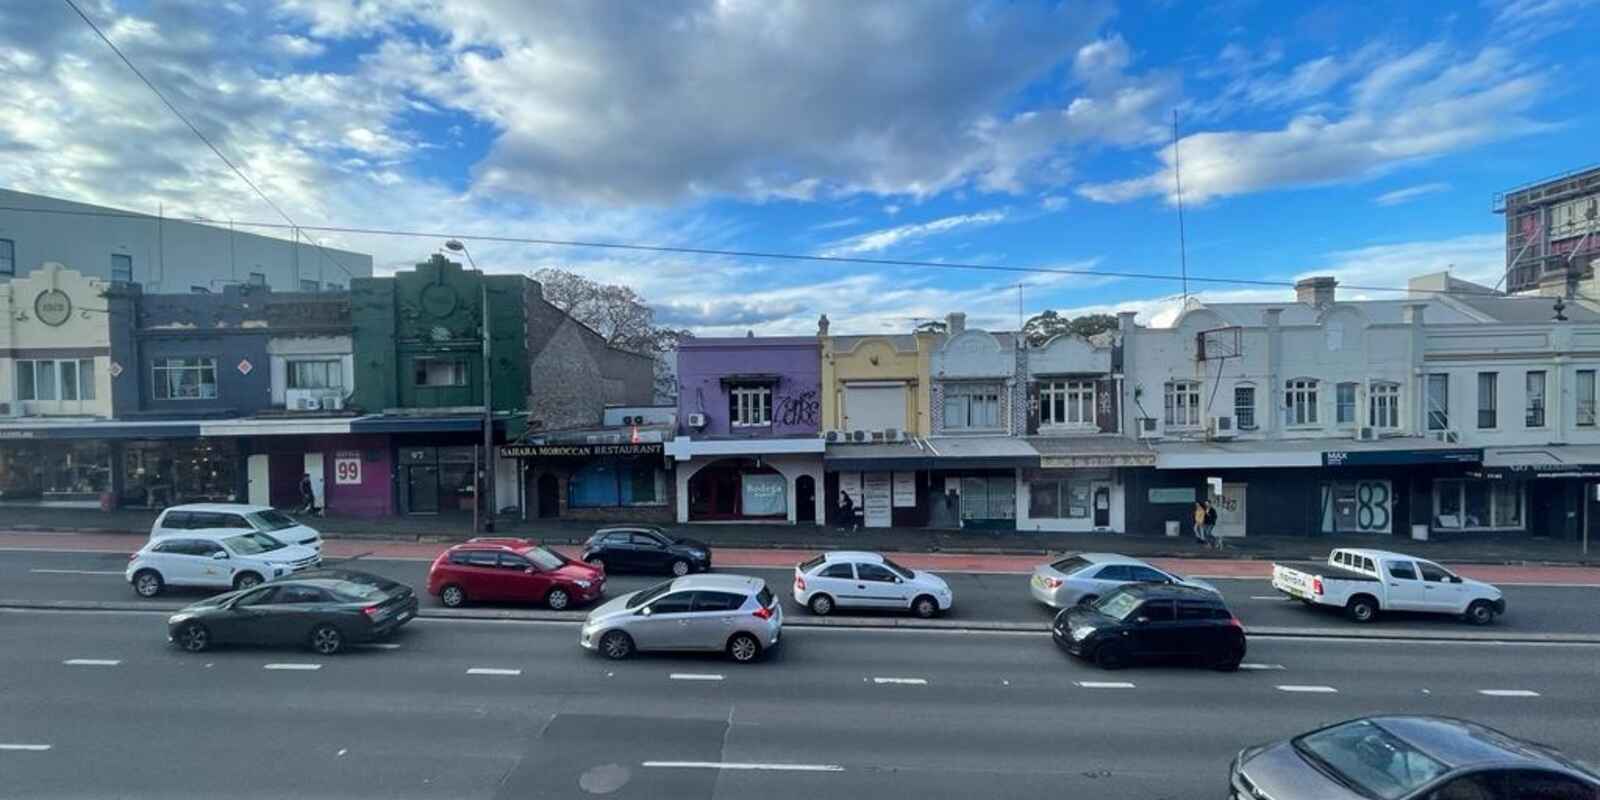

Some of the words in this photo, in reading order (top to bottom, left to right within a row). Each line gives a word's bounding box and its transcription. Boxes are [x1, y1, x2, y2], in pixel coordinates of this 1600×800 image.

[501, 448, 537, 457] SAHARA
[539, 447, 591, 456] MOROCCAN
[594, 445, 661, 455] RESTAURANT
[338, 461, 358, 480] 99
[1358, 482, 1389, 530] 83
